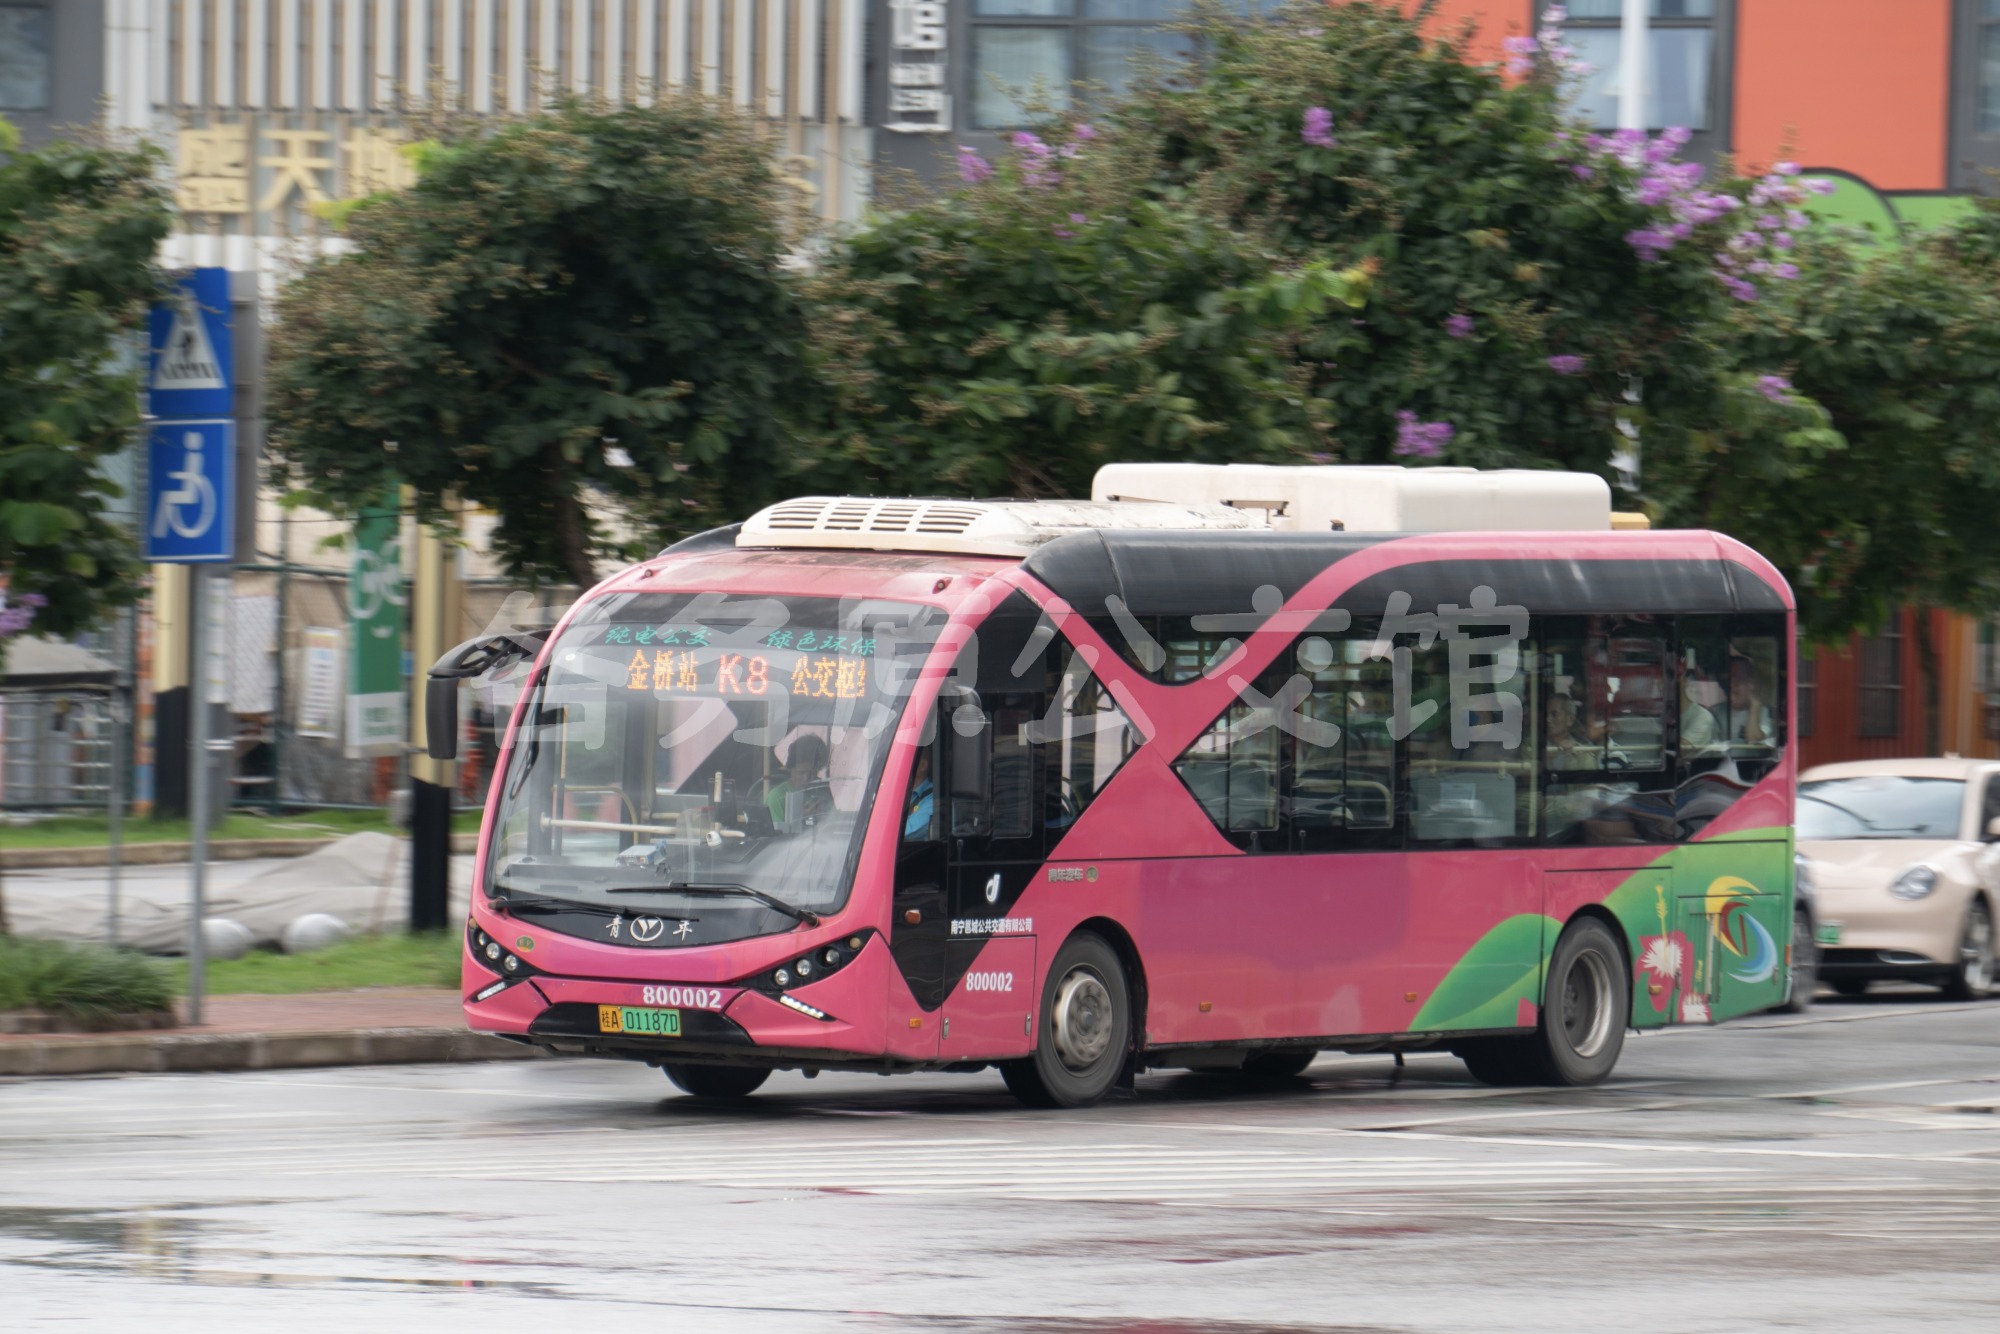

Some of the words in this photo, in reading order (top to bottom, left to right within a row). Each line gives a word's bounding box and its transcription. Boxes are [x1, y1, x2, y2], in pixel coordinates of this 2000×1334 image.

[605, 625, 712, 647] 纯电公交
[766, 630, 877, 656] 绿色环保
[627, 650, 698, 692] 金桥站
[718, 654, 770, 695] K8
[950, 917, 1033, 935] 南宁邕城公共交通有限公司
[966, 972, 1014, 991] 800002
[642, 985, 722, 1008] 800002
